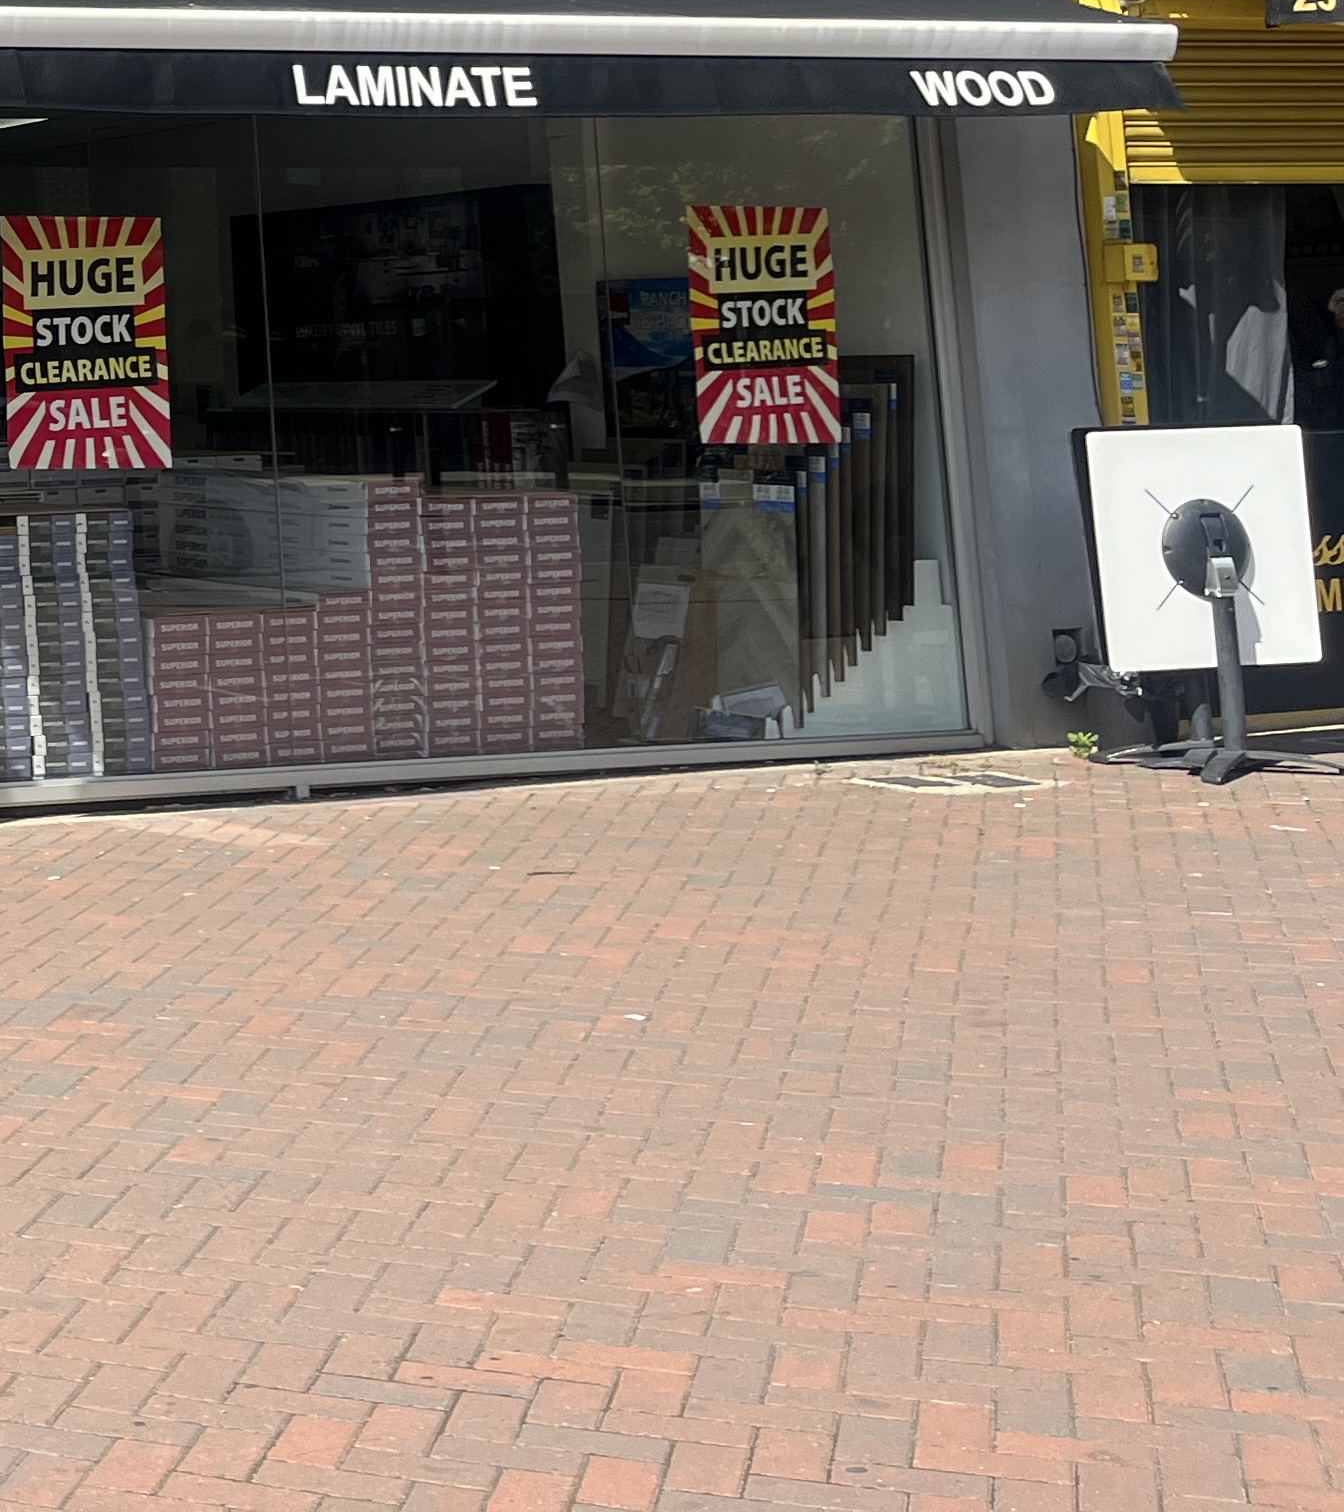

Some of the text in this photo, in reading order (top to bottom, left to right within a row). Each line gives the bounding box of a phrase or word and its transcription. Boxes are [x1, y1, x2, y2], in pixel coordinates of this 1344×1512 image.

[291, 63, 539, 108] LAMINATE
[908, 69, 1057, 108] WOOD
[30, 257, 135, 297] HUGE
[714, 244, 808, 282] HUGE
[35, 313, 132, 347] STOCK
[721, 297, 806, 329] STOCK
[707, 336, 824, 365] CLEARANCE
[20, 355, 153, 385] CLEARANCE
[736, 374, 805, 409] SALE
[48, 396, 128, 432] SALE
